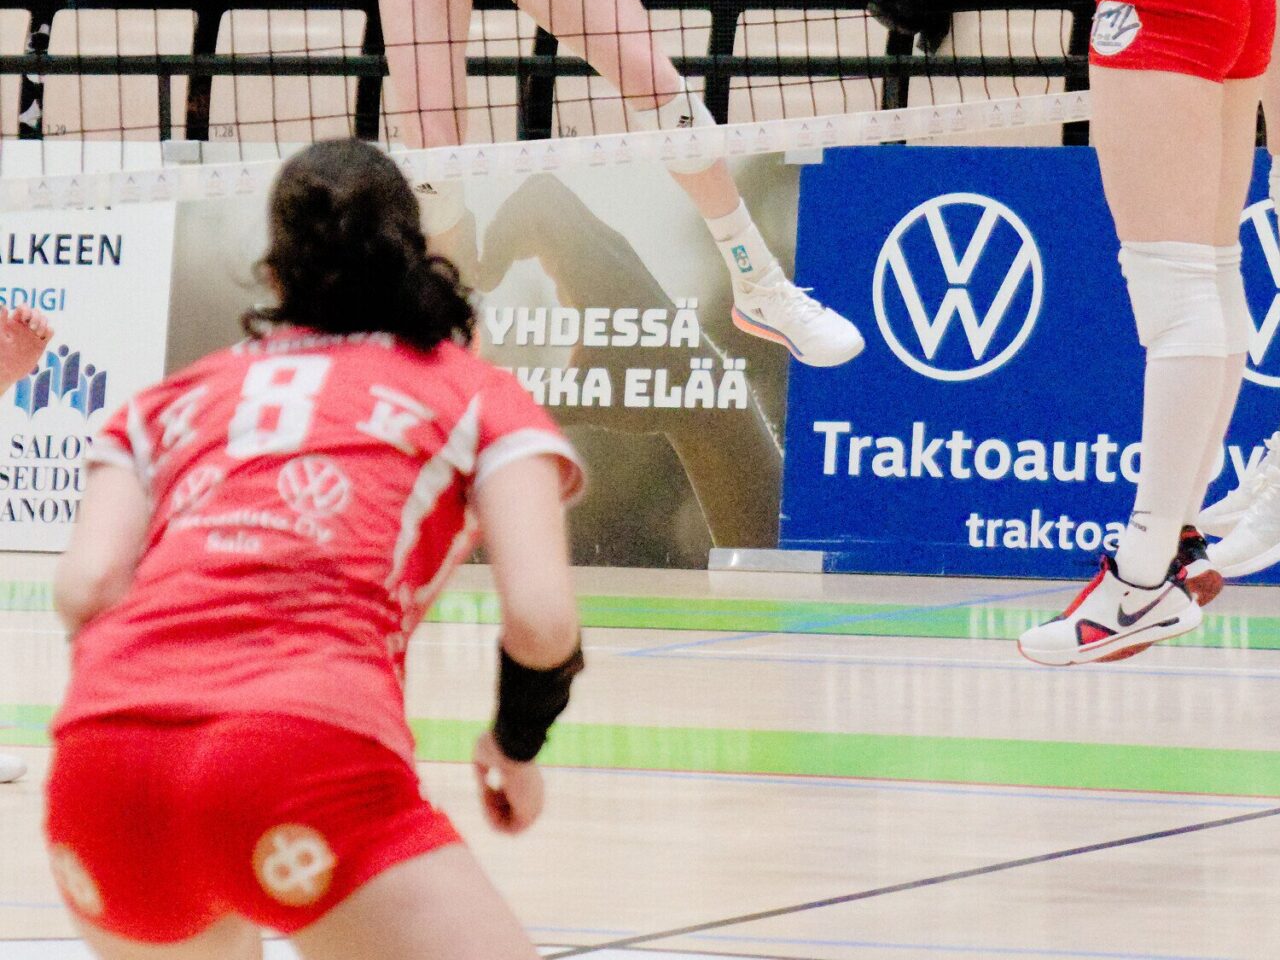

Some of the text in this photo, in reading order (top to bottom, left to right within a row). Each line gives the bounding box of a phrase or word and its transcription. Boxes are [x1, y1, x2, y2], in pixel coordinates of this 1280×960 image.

[0, 233, 122, 266] LKEEN
[486, 298, 699, 348] YHDESSÄ
[227, 355, 332, 458] 8
[496, 358, 748, 410] KKA ELÄÄ
